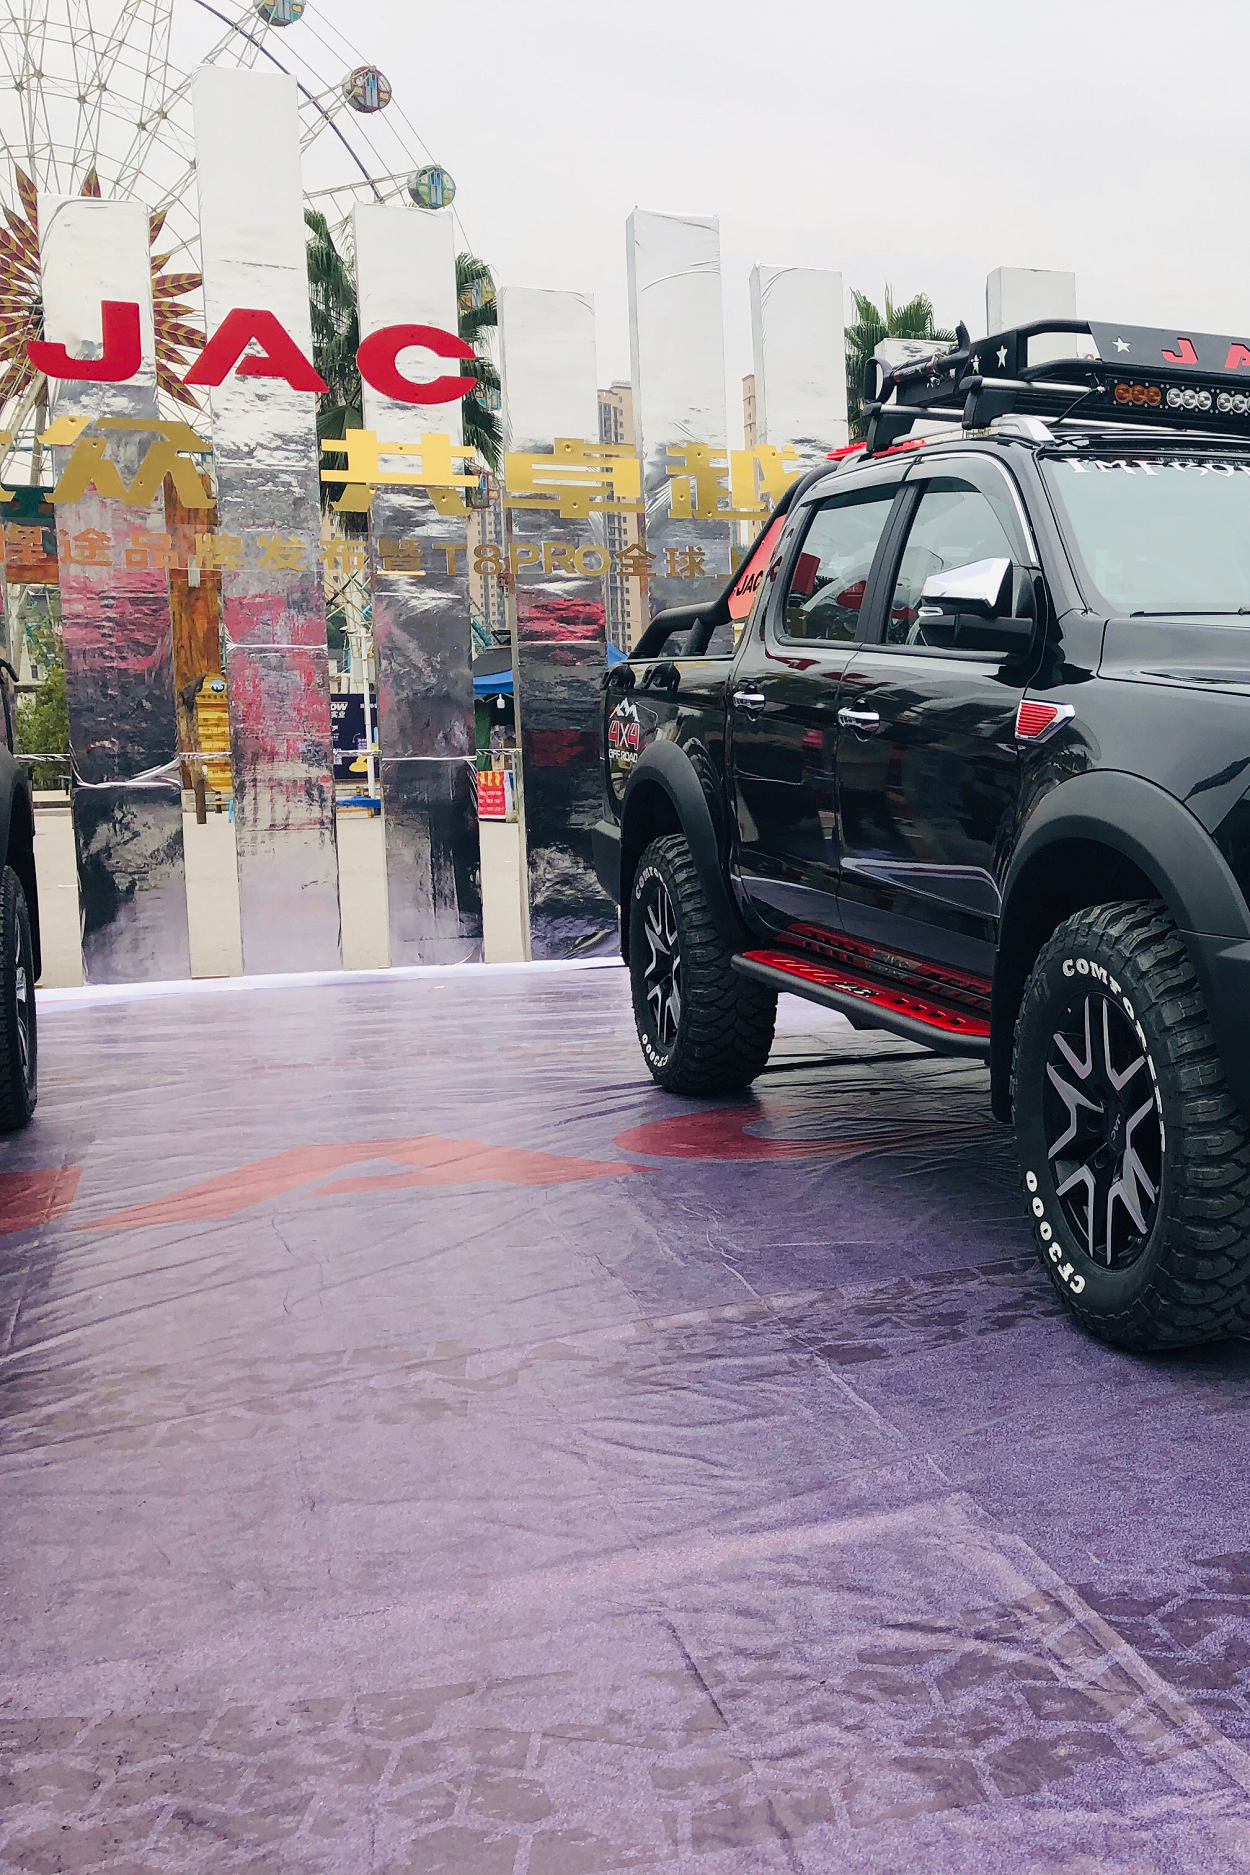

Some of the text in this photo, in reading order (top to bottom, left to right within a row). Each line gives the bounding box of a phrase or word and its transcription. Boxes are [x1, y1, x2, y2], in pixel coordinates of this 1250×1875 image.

[27, 300, 477, 404] JAC
[736, 570, 763, 597] JAC
[1026, 1170, 1086, 1294] CF3000
